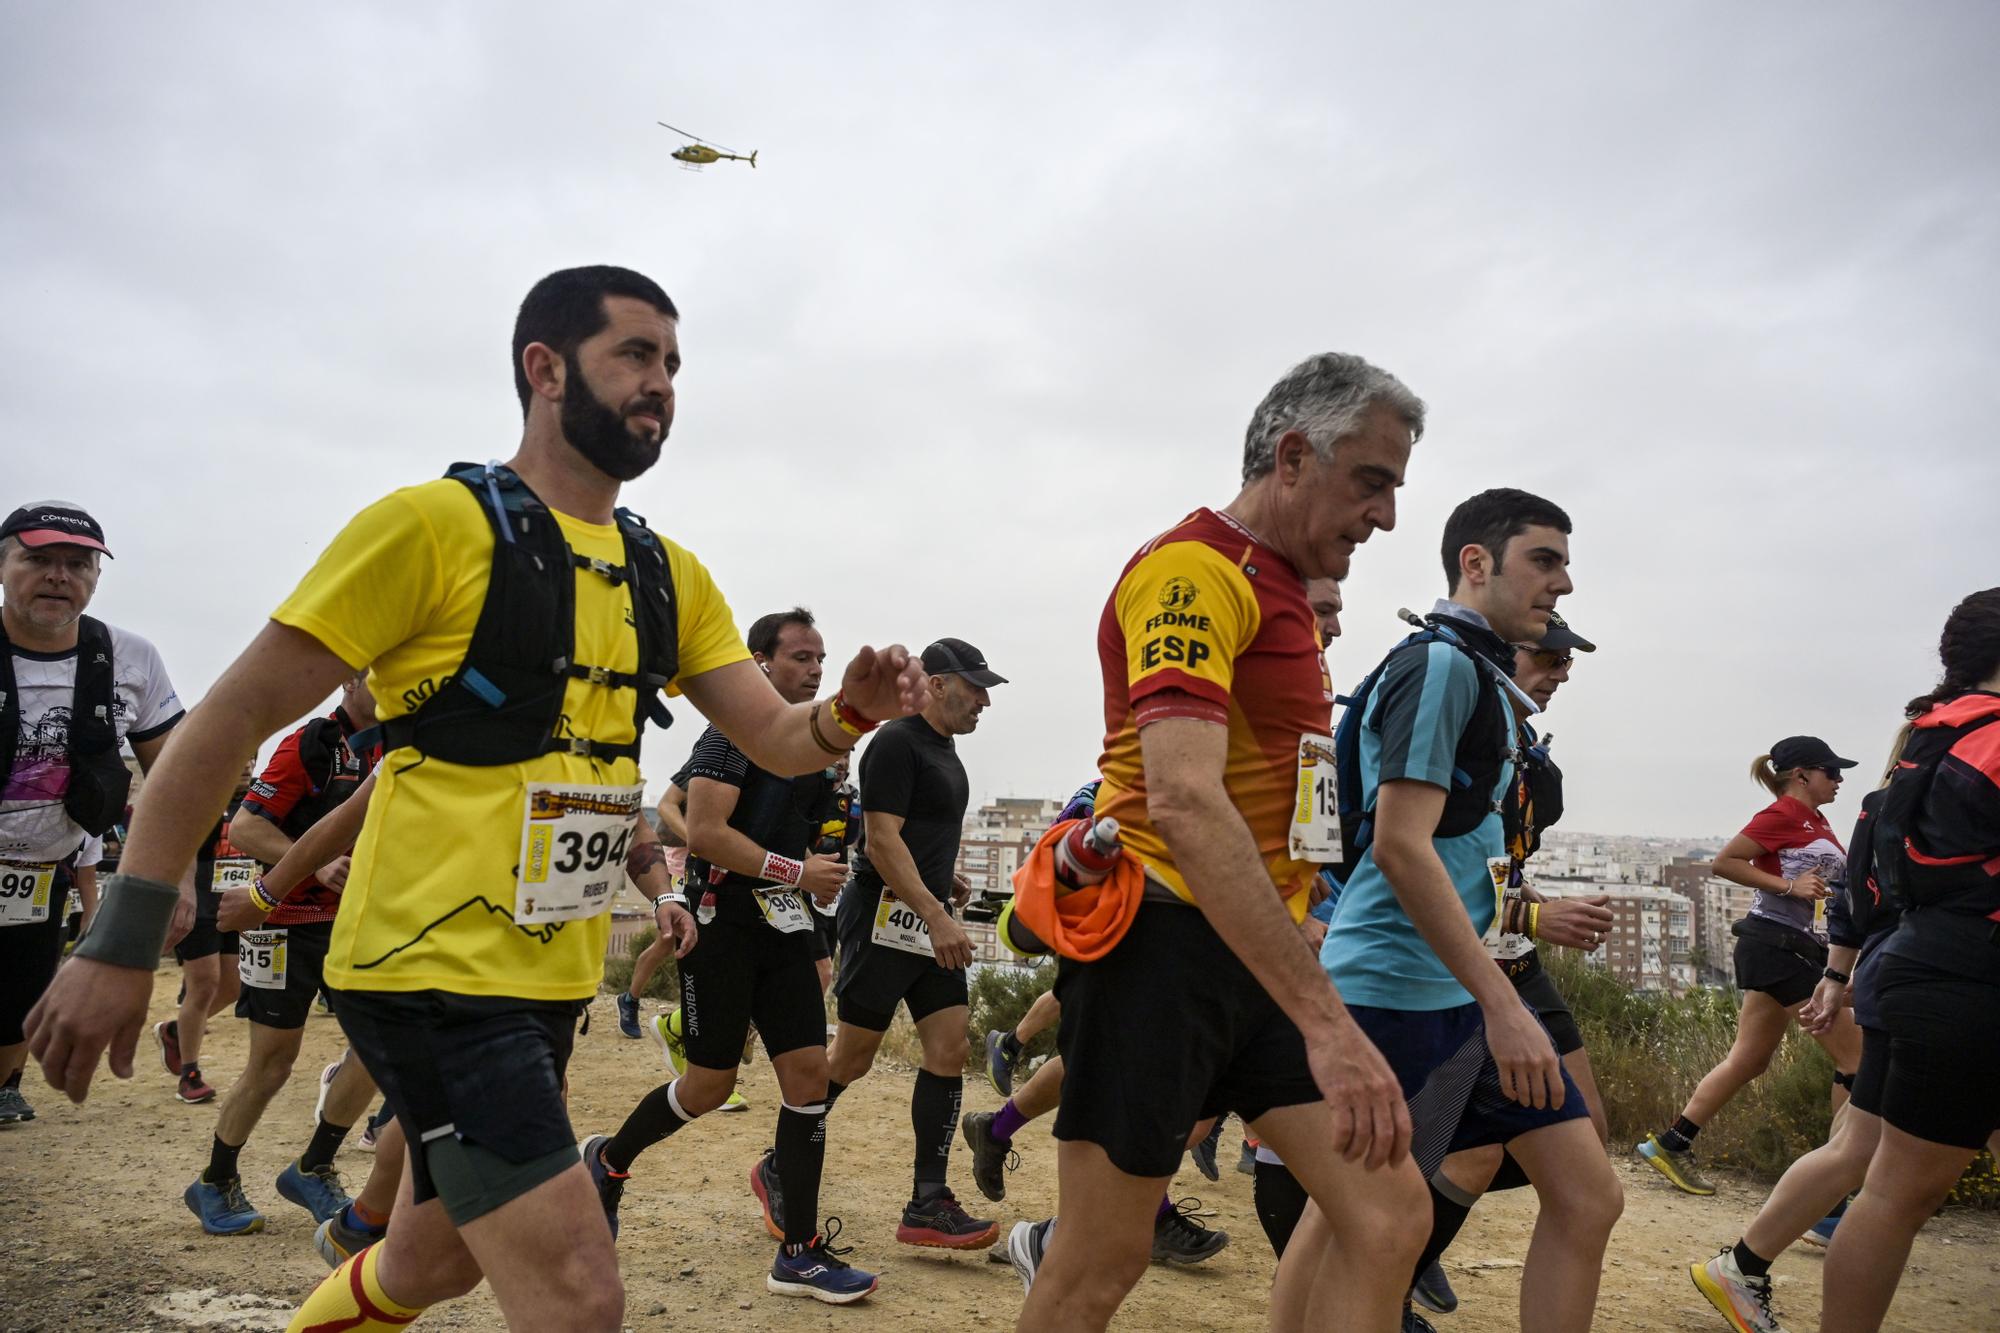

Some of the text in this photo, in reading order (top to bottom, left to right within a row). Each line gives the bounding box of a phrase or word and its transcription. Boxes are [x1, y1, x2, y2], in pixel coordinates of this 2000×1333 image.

[1146, 612, 1210, 633] FEDME
[1146, 635, 1210, 669] ESP
[572, 792, 597, 802] RUTA
[601, 794, 613, 804] DE
[614, 794, 631, 805] LAS
[1316, 777, 1338, 816] 15
[554, 824, 636, 873] 394
[223, 870, 251, 881] 1643
[937, 1090, 963, 1157] Kalenji
